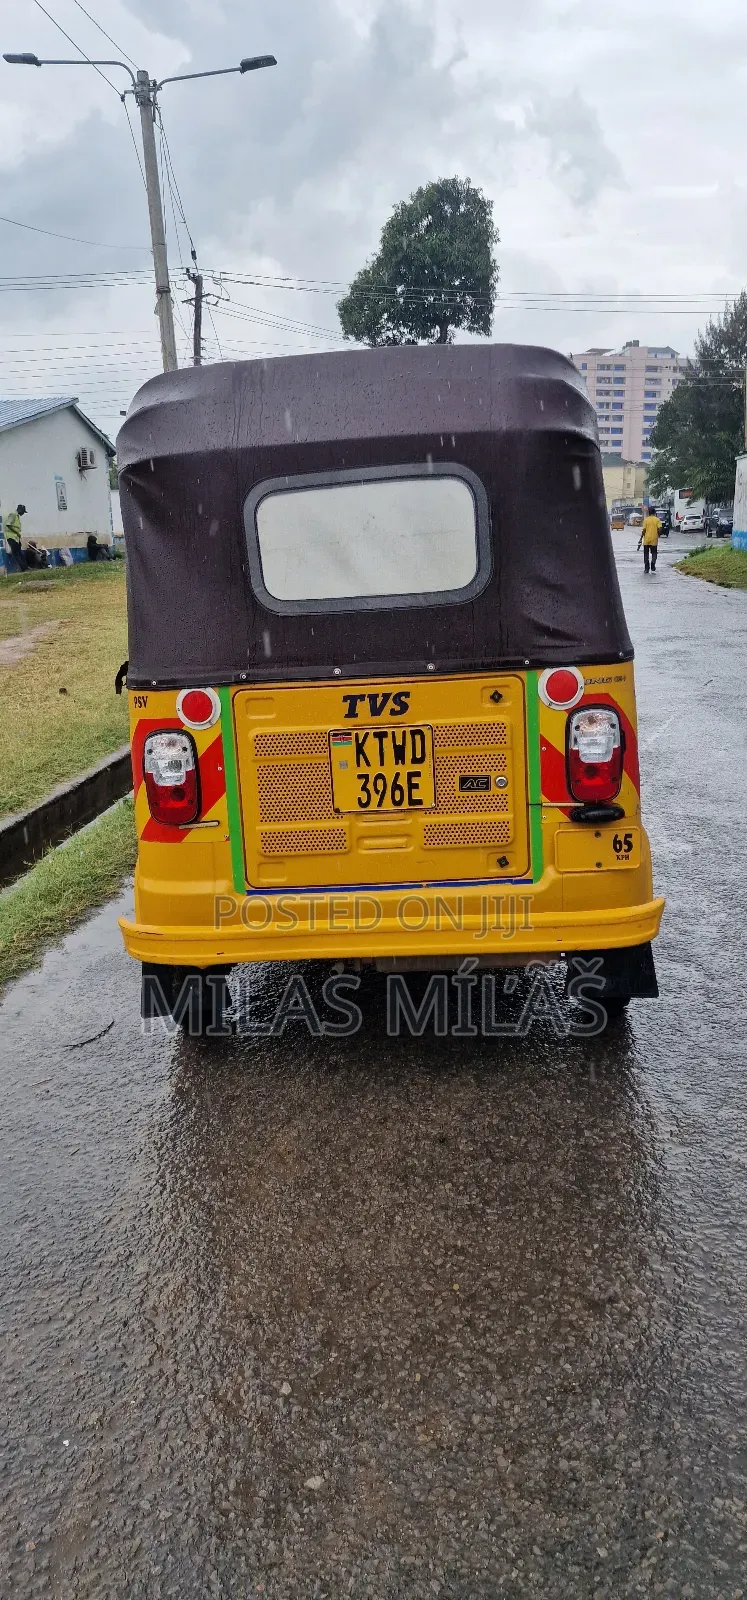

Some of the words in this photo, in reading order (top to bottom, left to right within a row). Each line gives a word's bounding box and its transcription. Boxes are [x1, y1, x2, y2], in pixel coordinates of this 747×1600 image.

[133, 695, 148, 709] PSV
[342, 691, 411, 719] TVS
[354, 729, 426, 767] KTWD
[356, 770, 423, 808] 396E
[462, 778, 488, 789] AC
[612, 833, 634, 853] 65
